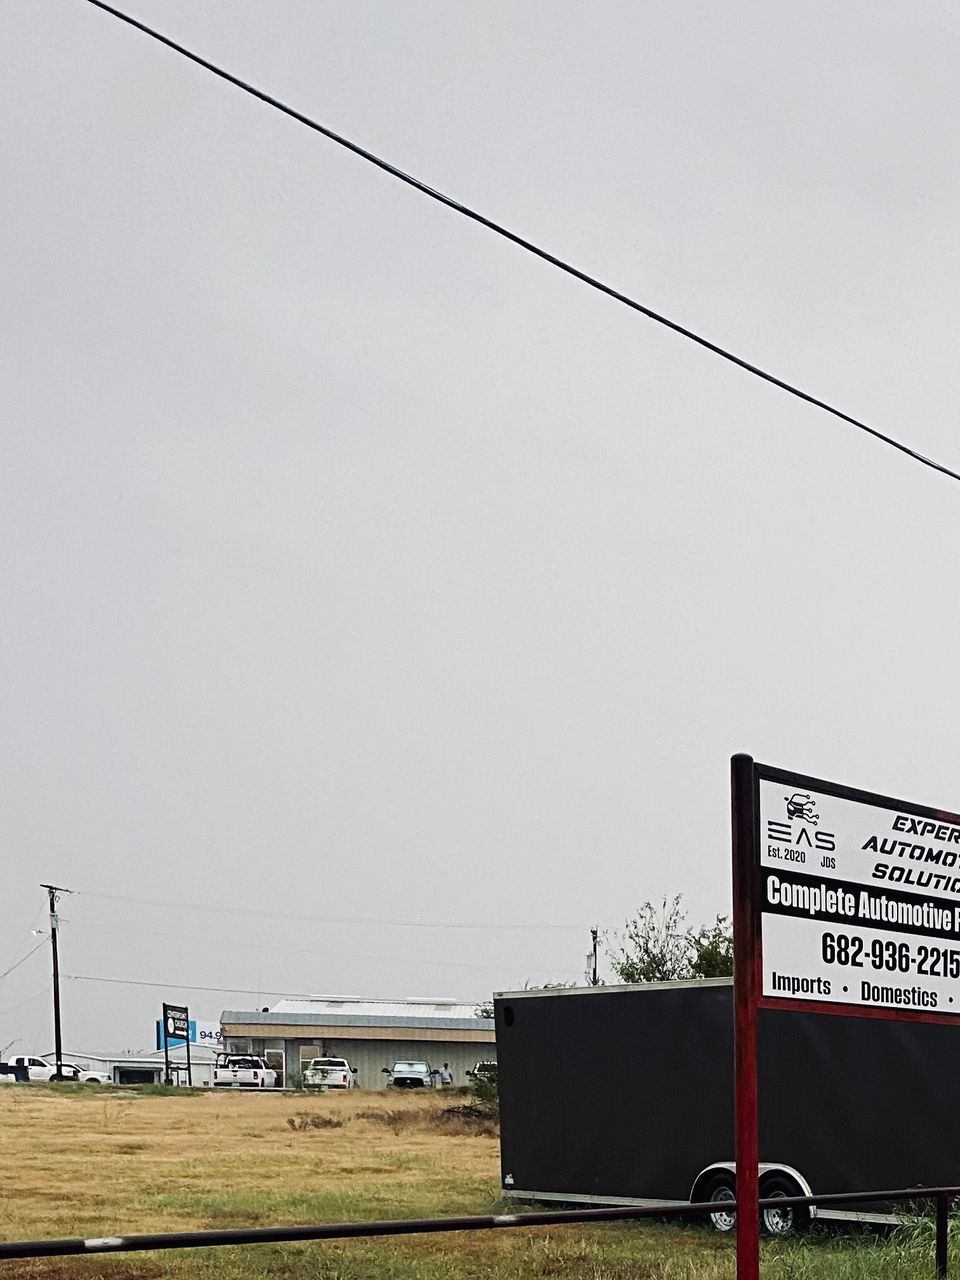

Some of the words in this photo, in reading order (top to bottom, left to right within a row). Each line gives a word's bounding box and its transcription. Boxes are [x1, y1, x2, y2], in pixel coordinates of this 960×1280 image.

[767, 820, 835, 852] EAS
[767, 845, 783, 860] Est.
[784, 847, 806, 864] 2020
[820, 855, 836, 870] JDS
[767, 876, 855, 917] Complete
[858, 891, 952, 931] Automotive
[822, 932, 960, 979] 682-936-2215
[771, 971, 831, 996] Imports
[861, 981, 938, 1008] Domestics
[199, 1030, 222, 1040] 94.9
